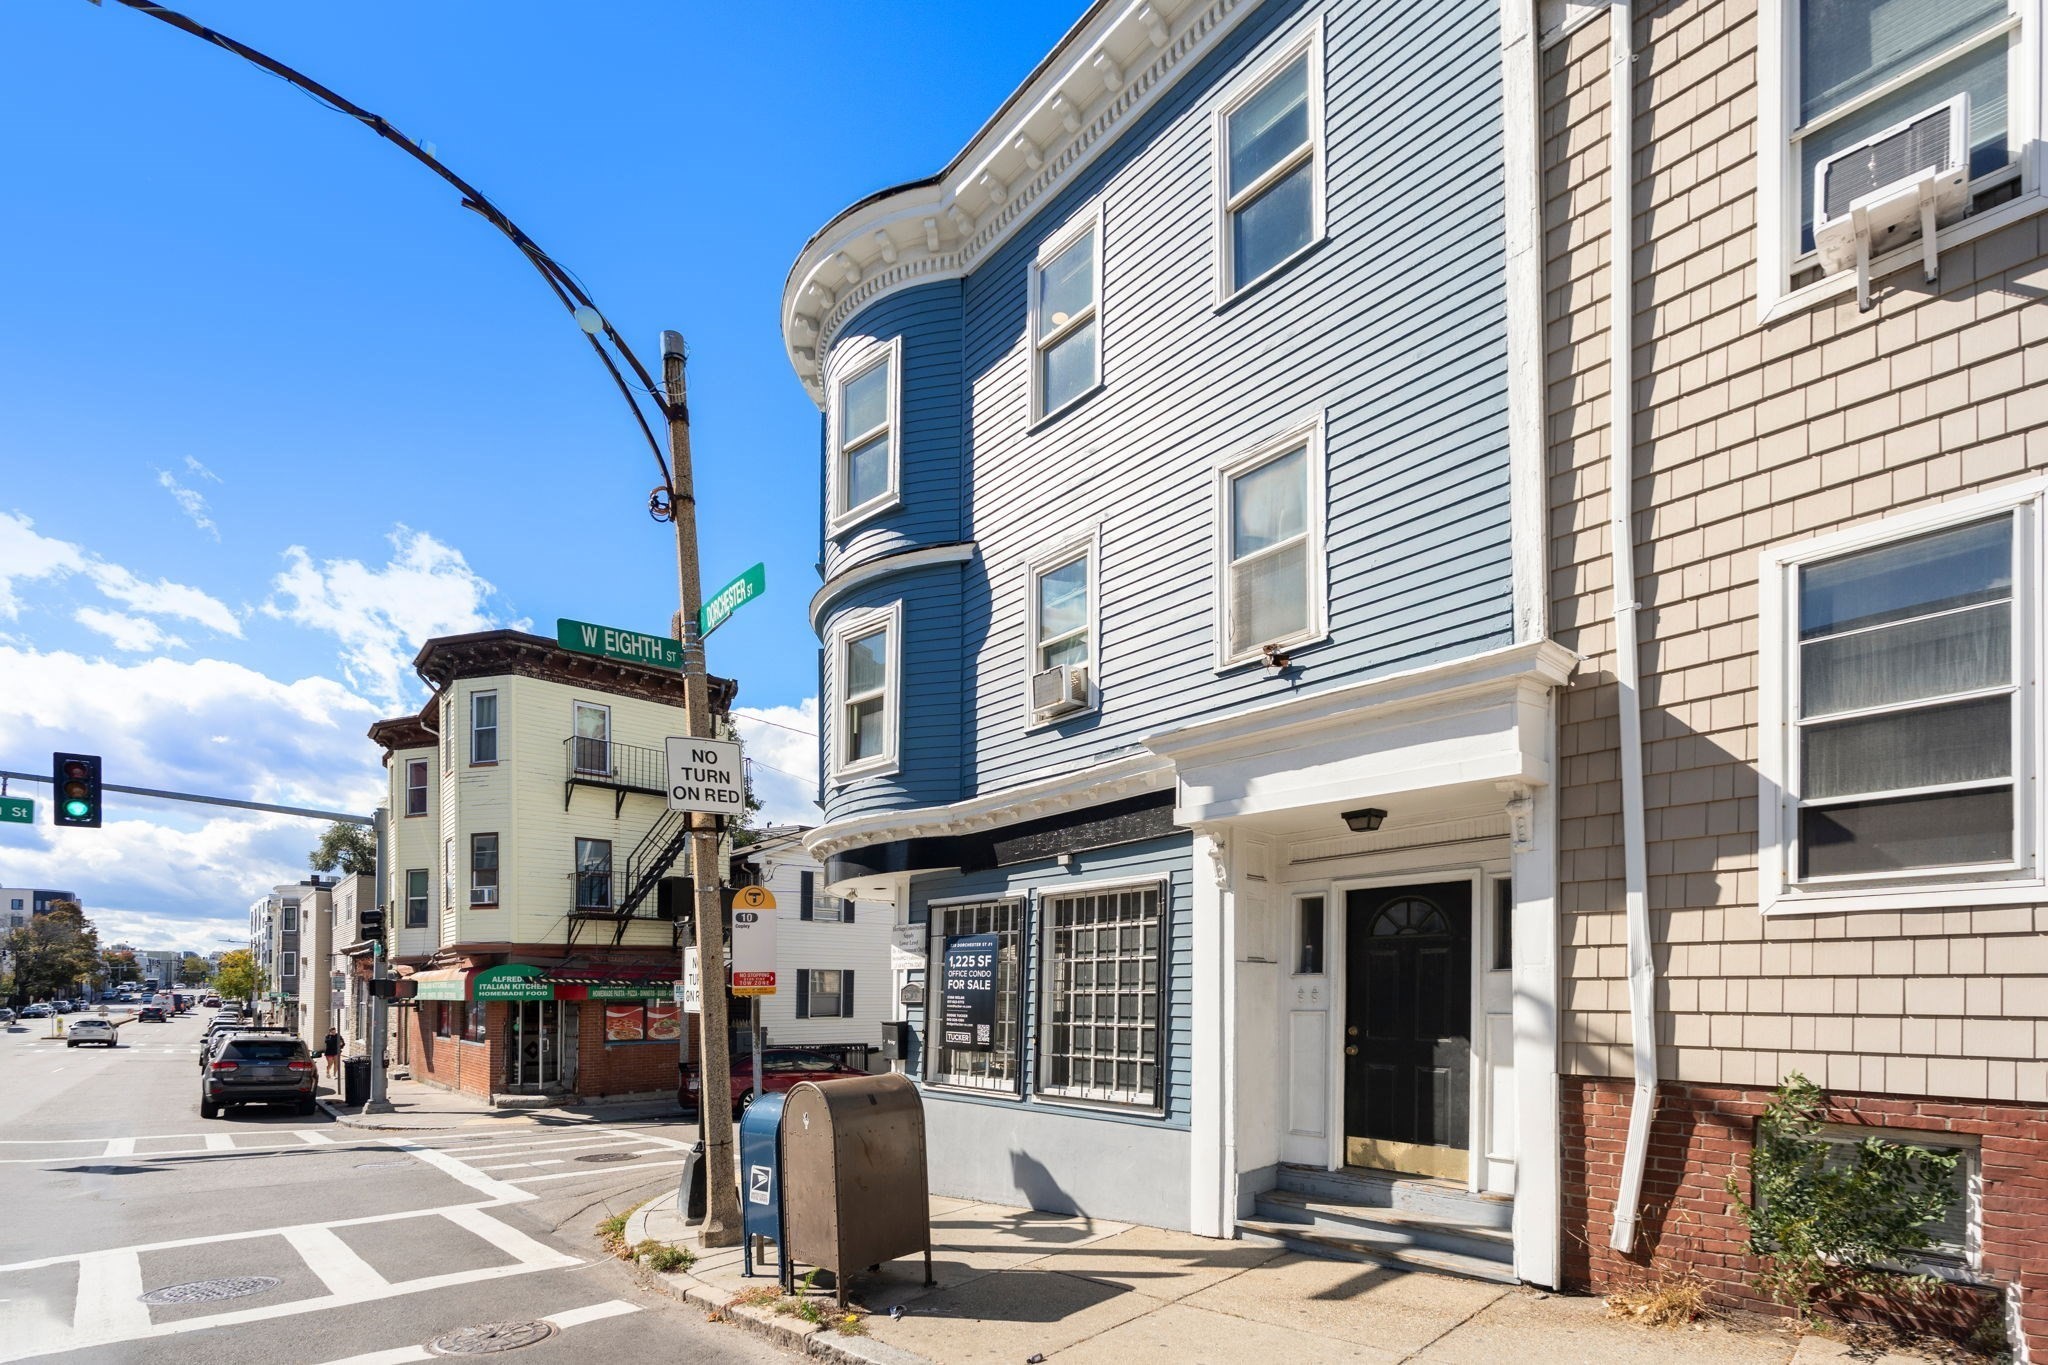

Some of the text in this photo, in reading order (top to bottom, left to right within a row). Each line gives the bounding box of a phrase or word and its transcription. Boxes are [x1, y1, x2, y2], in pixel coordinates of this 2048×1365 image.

[706, 579, 753, 627] DORCHESTER ST
[582, 625, 676, 662] W EIGHTH ST
[692, 749, 718, 764] NO
[681, 767, 730, 785] TURN
[673, 786, 740, 804] ON RED
[12, 807, 28, 817] St
[949, 955, 992, 969] 1,225 SF
[948, 980, 991, 990] FOR SALE
[948, 1033, 969, 1041] TUCKER
